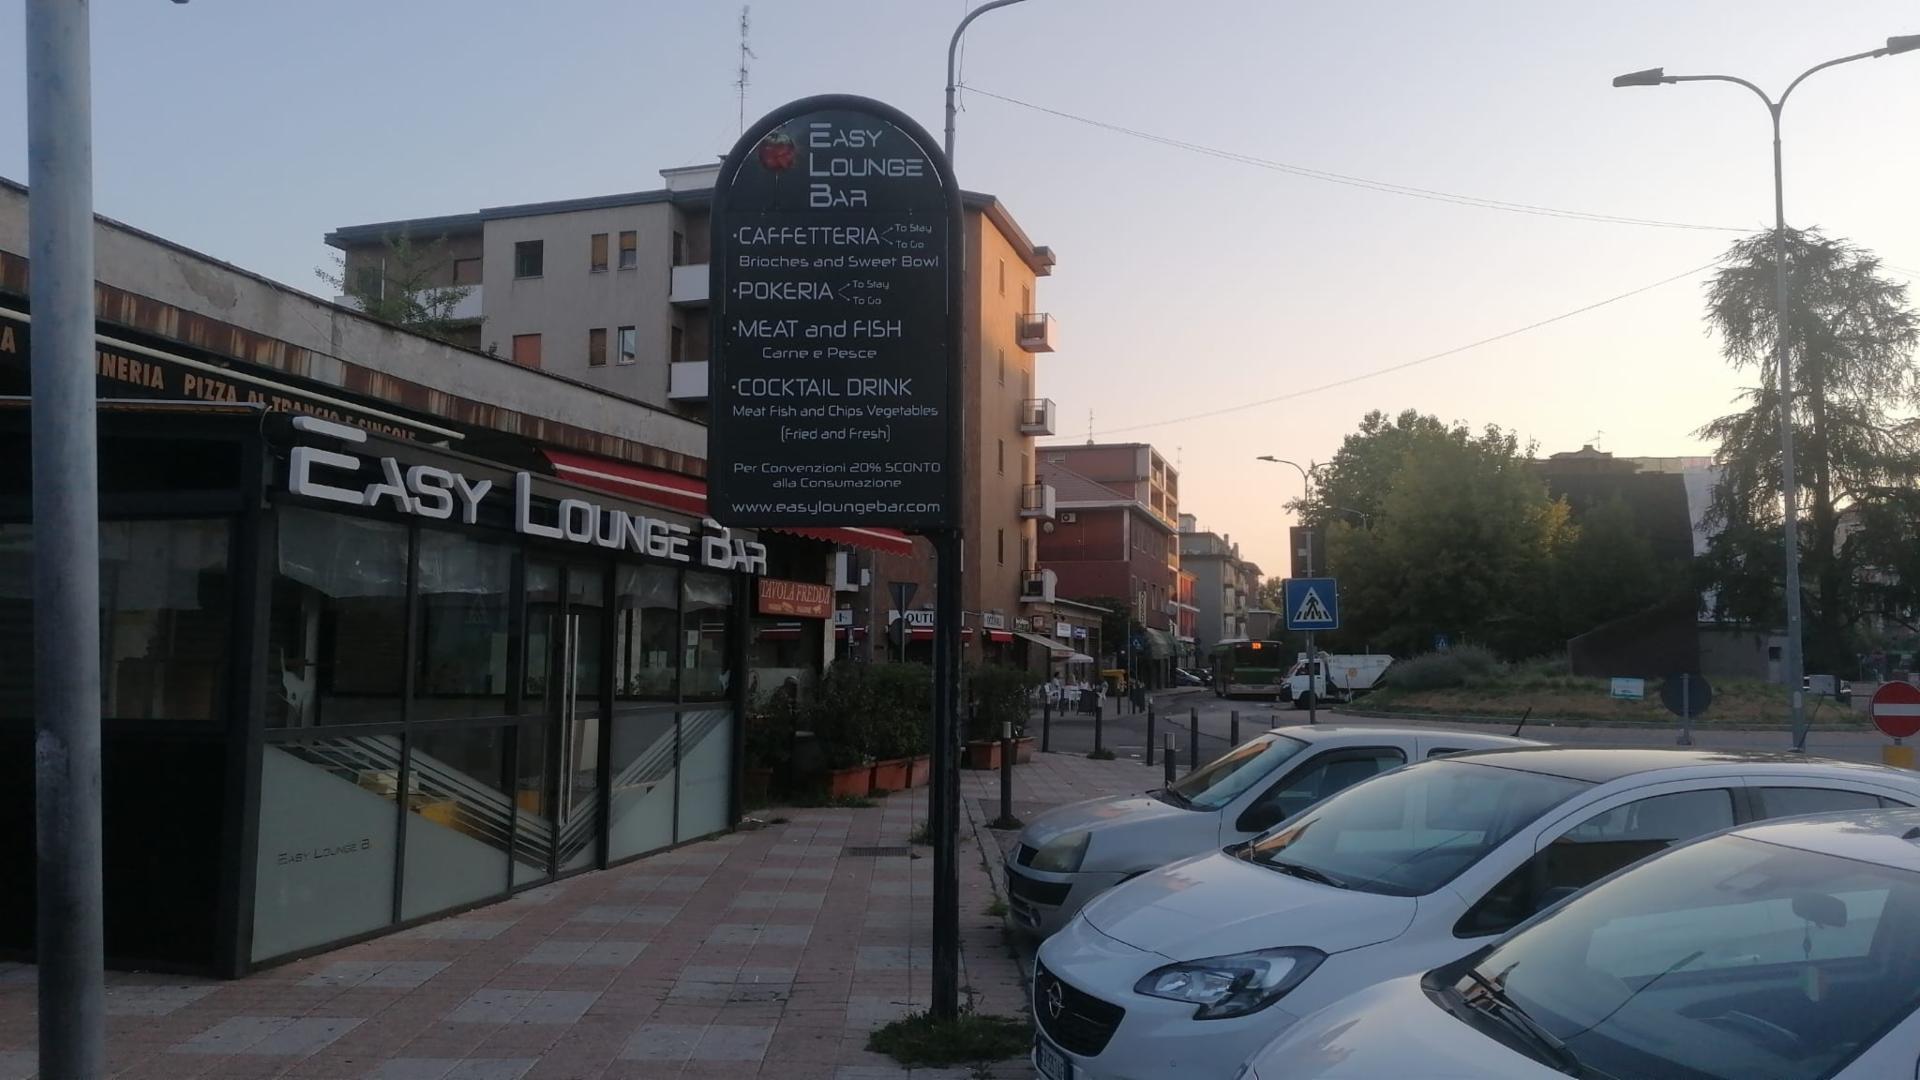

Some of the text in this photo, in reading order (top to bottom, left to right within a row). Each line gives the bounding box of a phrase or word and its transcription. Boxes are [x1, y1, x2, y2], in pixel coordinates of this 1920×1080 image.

[894, 224, 932, 234] To Stay
[739, 227, 880, 245] CAFFETTERIA
[896, 240, 908, 249] To
[739, 255, 939, 267] Brioches and Sweet Bowl
[739, 282, 834, 300] POKERIA
[852, 280, 890, 291] To Stay
[853, 296, 864, 305] To
[738, 320, 902, 338] MEAT and FISH
[762, 347, 877, 359] Carne e Pesce
[184, 373, 237, 403] PIZZA
[738, 378, 912, 396] COCKTAIL DRINK
[733, 405, 939, 419] Meat Fish and Chips Vegetables
[821, 428, 846, 439] and
[734, 462, 941, 473] Per Convenzioni 20% SCONTO
[772, 478, 902, 488] alla Consumazione
[731, 501, 941, 515] www.easyloungebar.com
[760, 579, 831, 605] TAVOLA FREDDA
